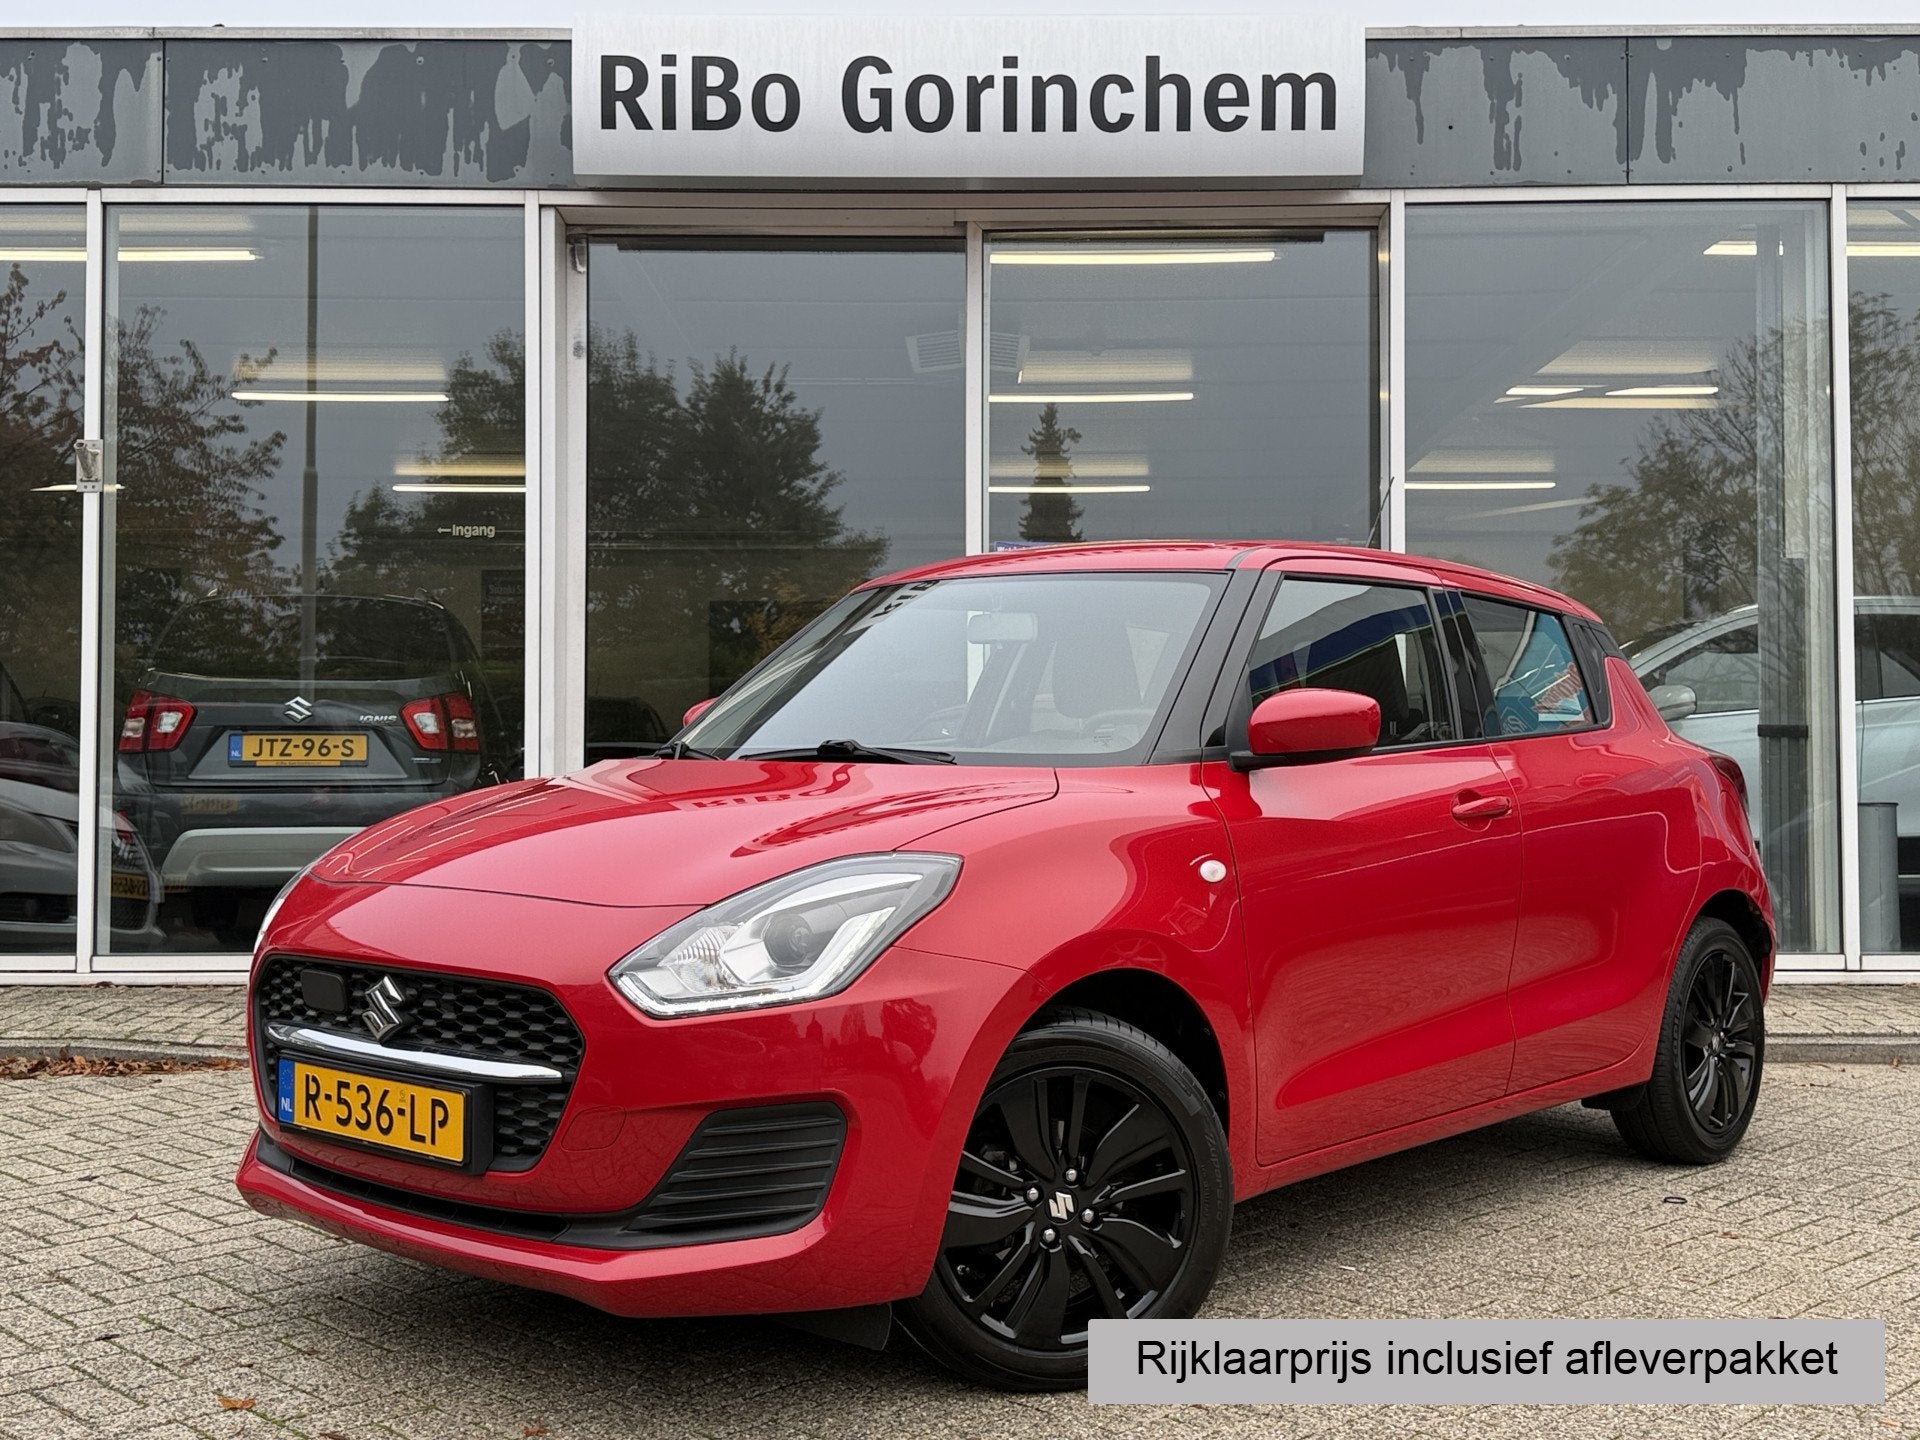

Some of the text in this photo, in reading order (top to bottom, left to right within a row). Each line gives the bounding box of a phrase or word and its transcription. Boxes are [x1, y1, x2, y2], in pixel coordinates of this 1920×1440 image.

[600, 54, 1337, 134] RiBo Gorinchem
[452, 524, 496, 538] Ingang
[252, 738, 354, 758] JTZ-96-S
[281, 1073, 450, 1146] NL R-536-LP
